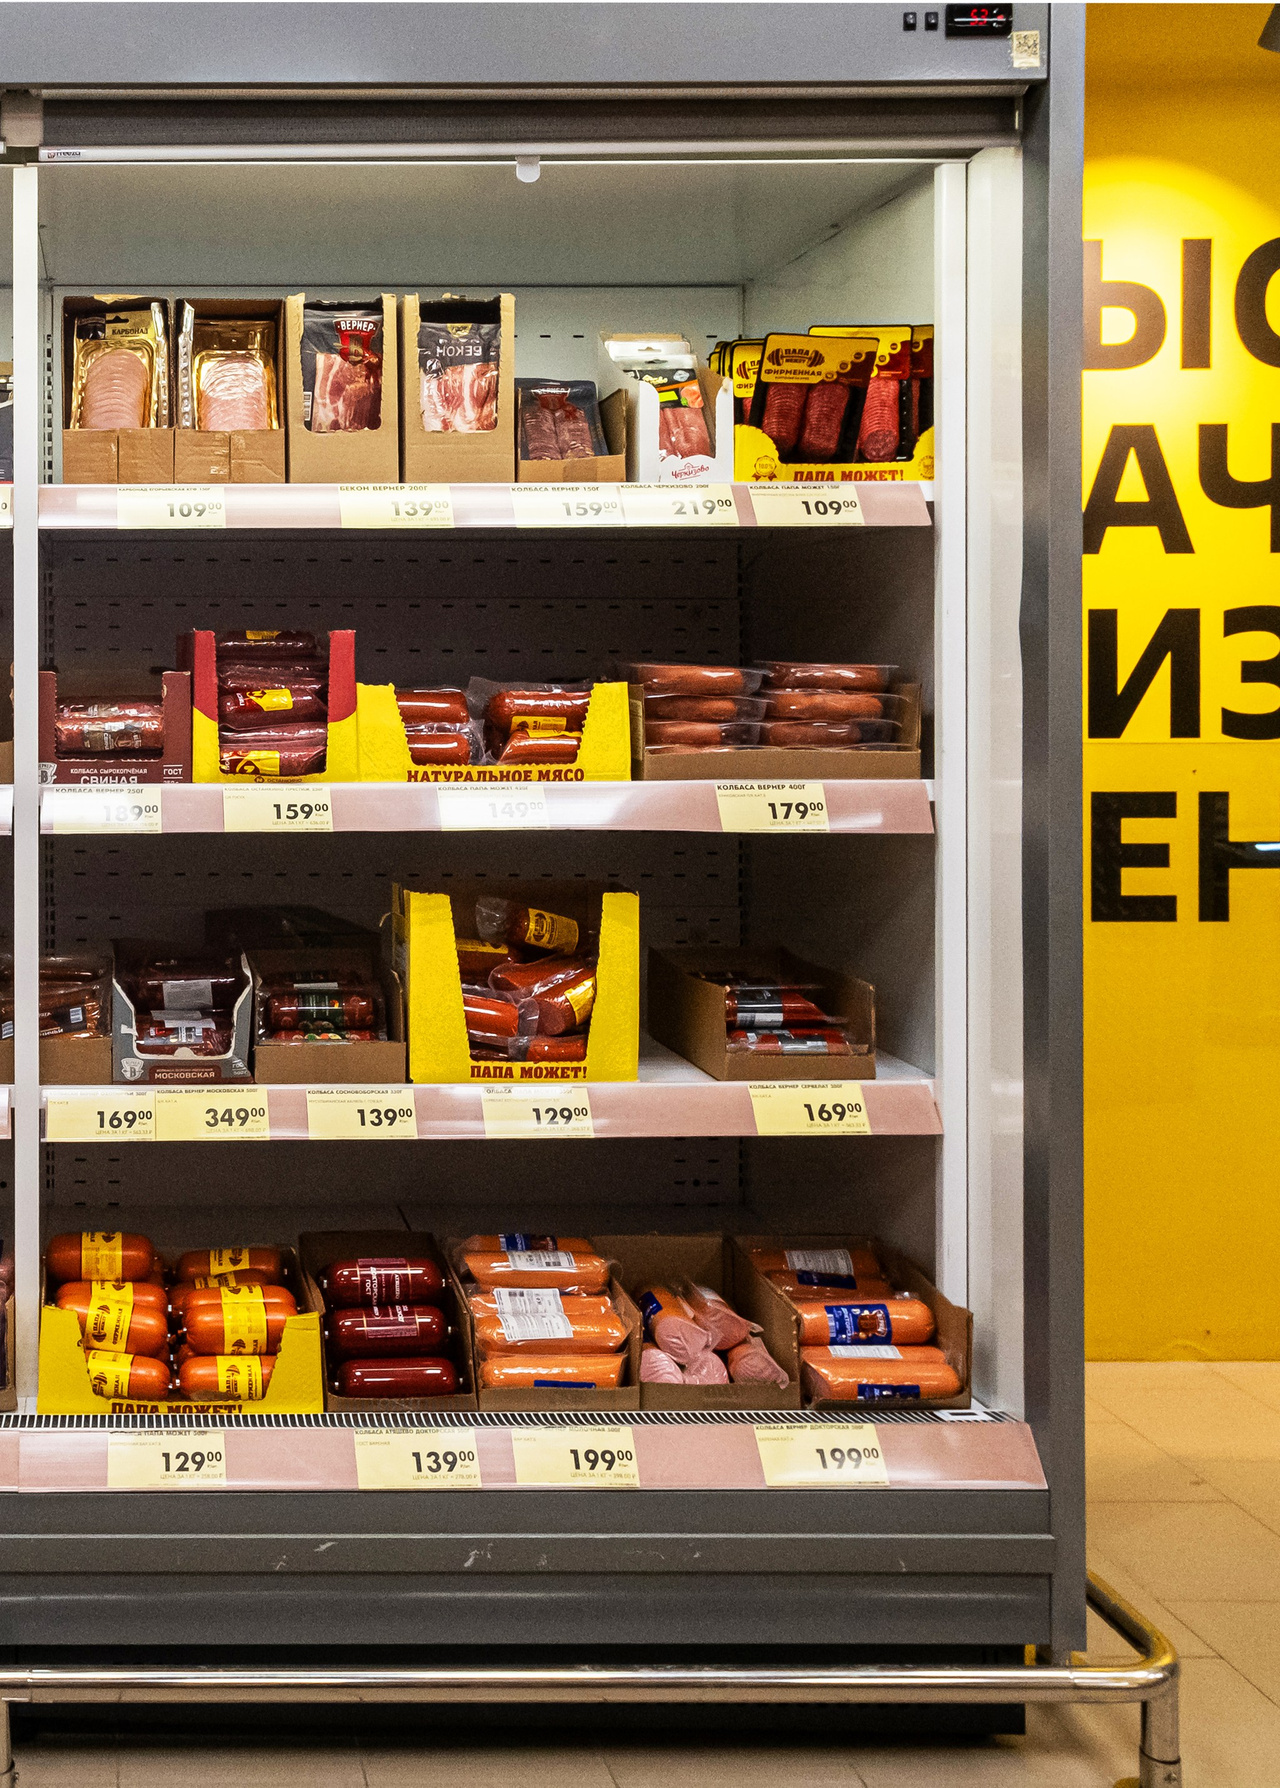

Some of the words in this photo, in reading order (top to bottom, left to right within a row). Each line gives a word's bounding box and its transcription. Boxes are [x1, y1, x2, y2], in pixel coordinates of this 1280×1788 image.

[340, 321, 373, 332] ВЕРНЕР
[785, 348, 810, 356] ПАПА
[793, 471, 835, 481] ПАПА
[840, 470, 904, 481] МОЖЕТ!
[1088, 605, 1280, 741] ИЗ
[407, 770, 532, 782] НАТУРАЛЬНОЕ
[537, 768, 584, 782] МЯСО
[470, 1066, 514, 1078] ПАПА
[520, 1066, 587, 1079] МОЖЕТ!
[111, 1403, 159, 1414] ПАПА
[167, 1404, 243, 1414] МОЖЕТ!
